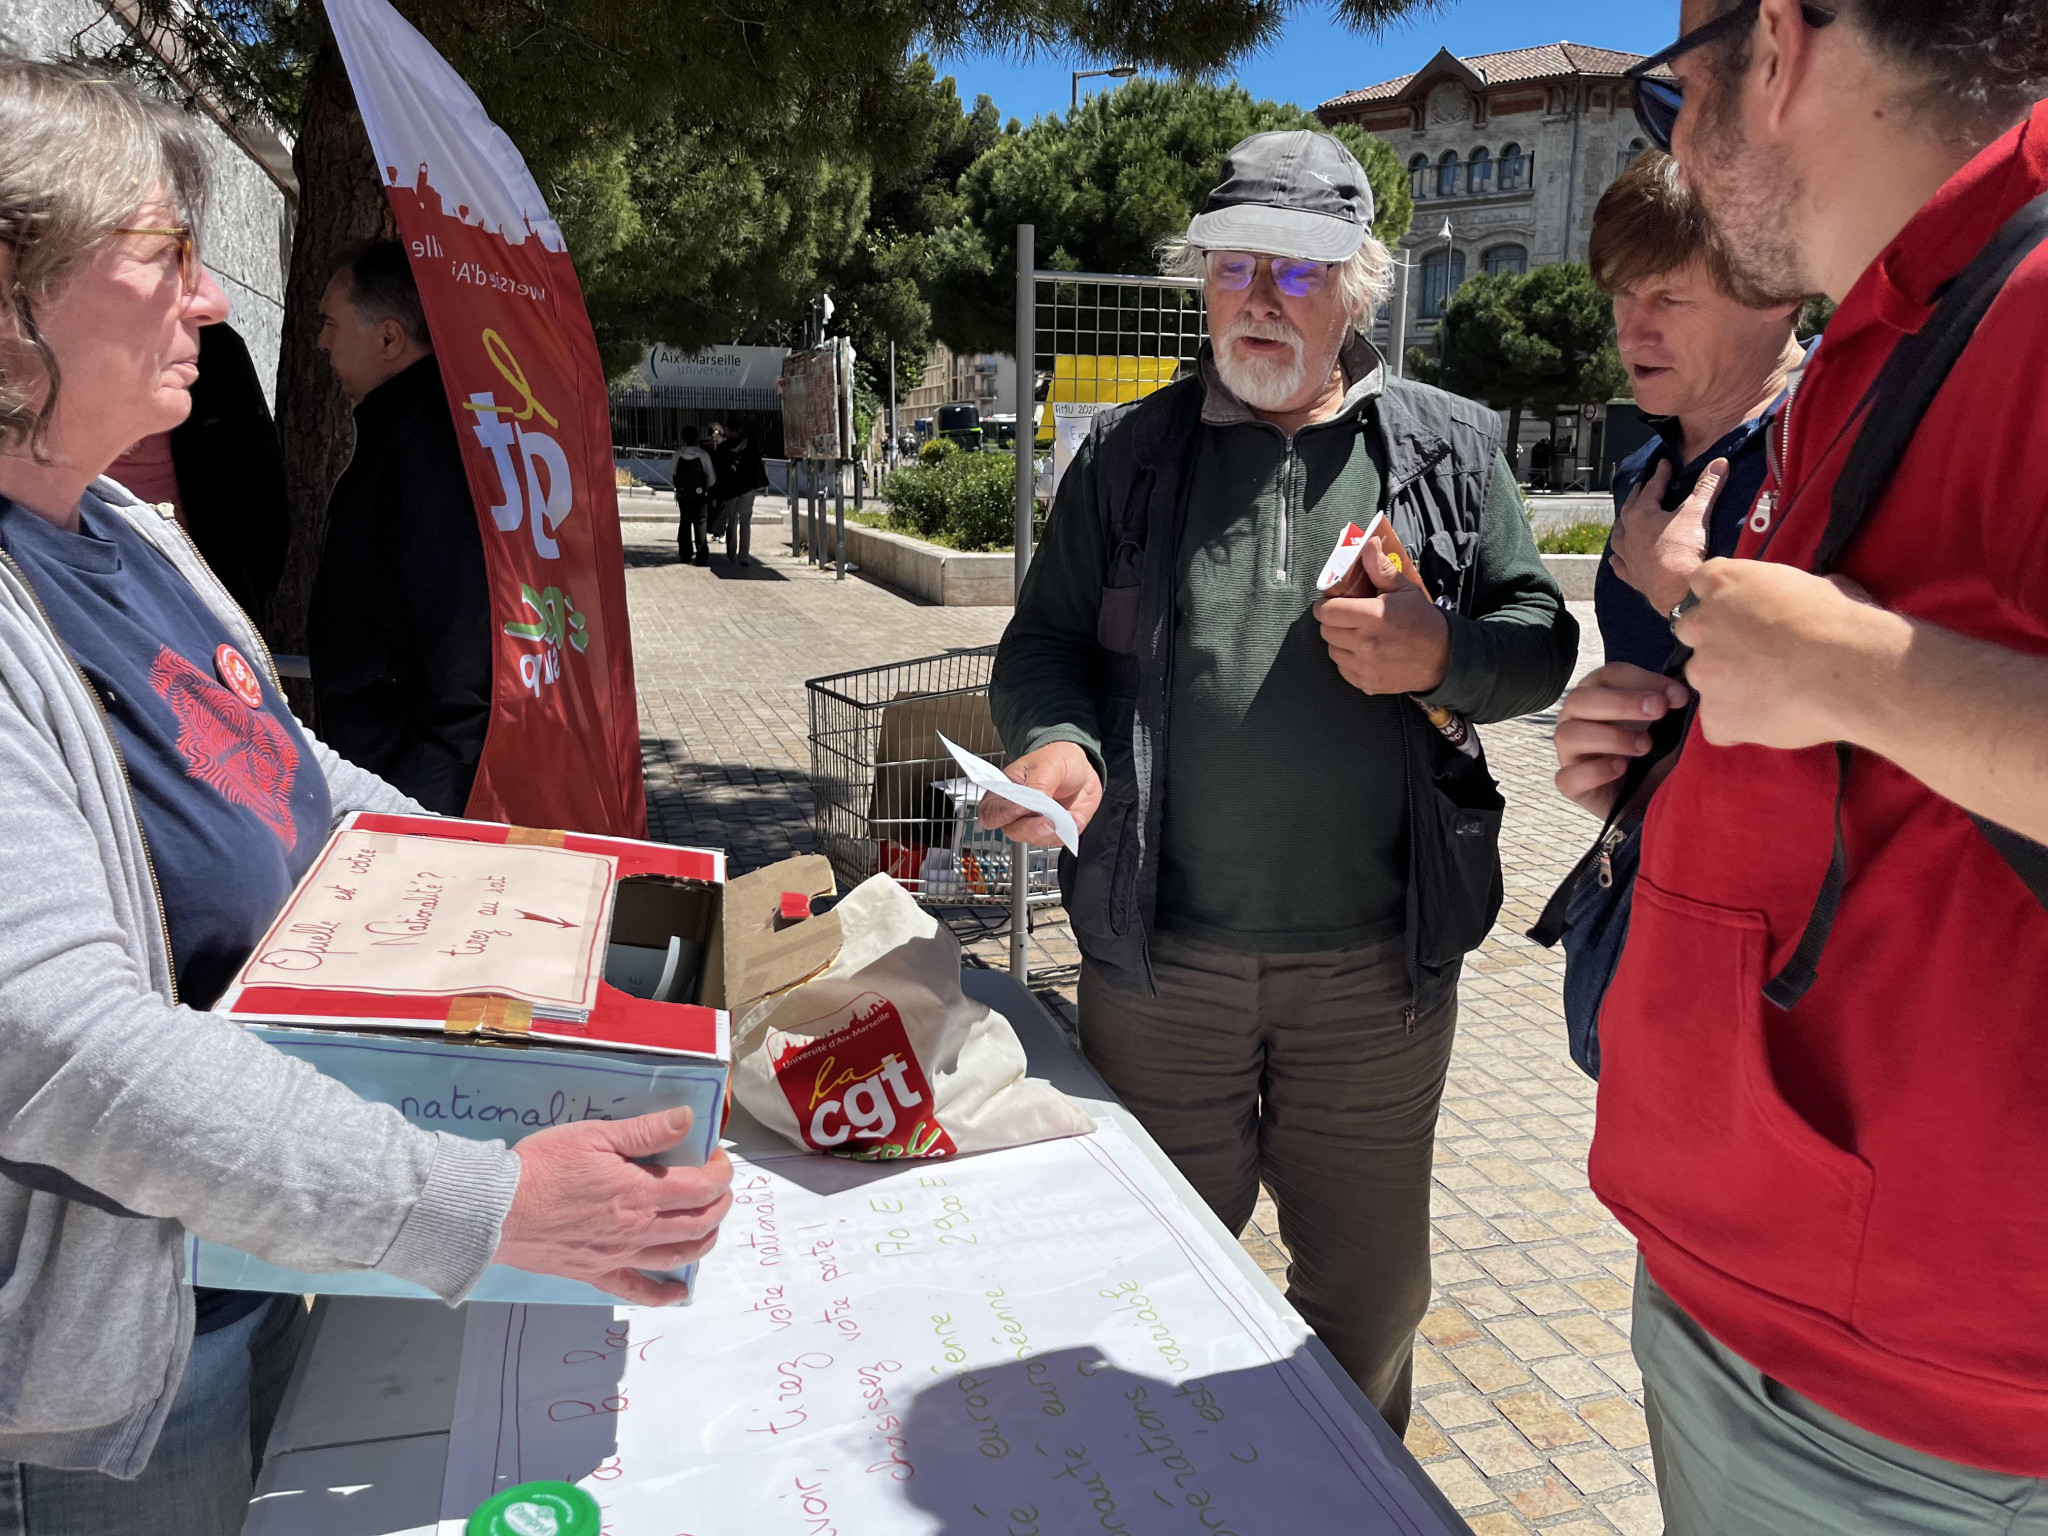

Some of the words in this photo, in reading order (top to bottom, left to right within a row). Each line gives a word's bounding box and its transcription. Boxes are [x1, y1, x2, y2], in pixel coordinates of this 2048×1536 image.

[660, 351, 680, 365] Aix
[687, 351, 742, 367] Marseille
[677, 363, 736, 377] université
[338, 846, 377, 875] votre
[324, 881, 357, 902] est
[437, 928, 512, 957] tirez
[479, 900, 500, 916] au
[781, 1041, 828, 1069] Université
[829, 1011, 891, 1049] d'Aix-Marseille
[809, 1053, 923, 1147] cgt
[743, 1284, 793, 1332] votre
[813, 1295, 861, 1342] votre
[746, 1352, 833, 1435] tirez
